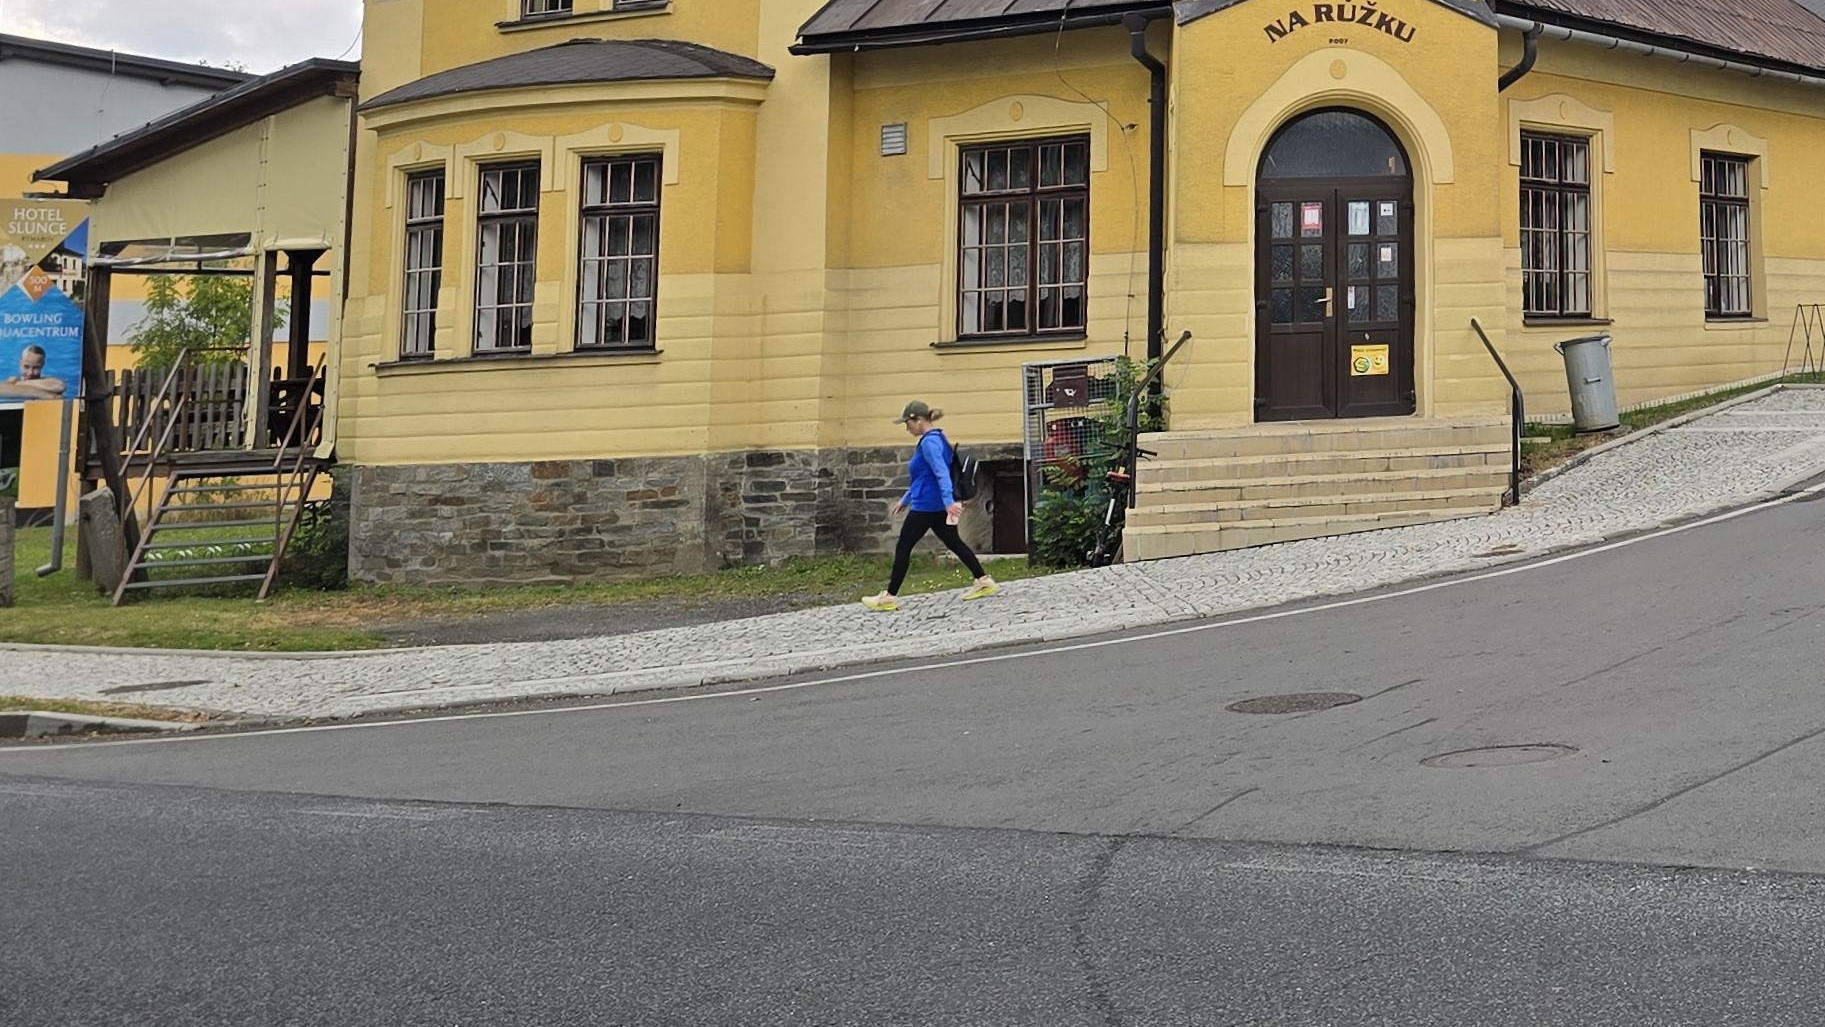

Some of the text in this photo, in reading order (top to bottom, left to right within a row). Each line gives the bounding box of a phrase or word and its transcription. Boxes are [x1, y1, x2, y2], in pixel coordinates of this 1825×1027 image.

[1263, 10, 1311, 44] NA
[14, 207, 63, 221] HOTEL
[8, 221, 67, 236] SLUNCE
[4, 312, 63, 325] BOWLING
